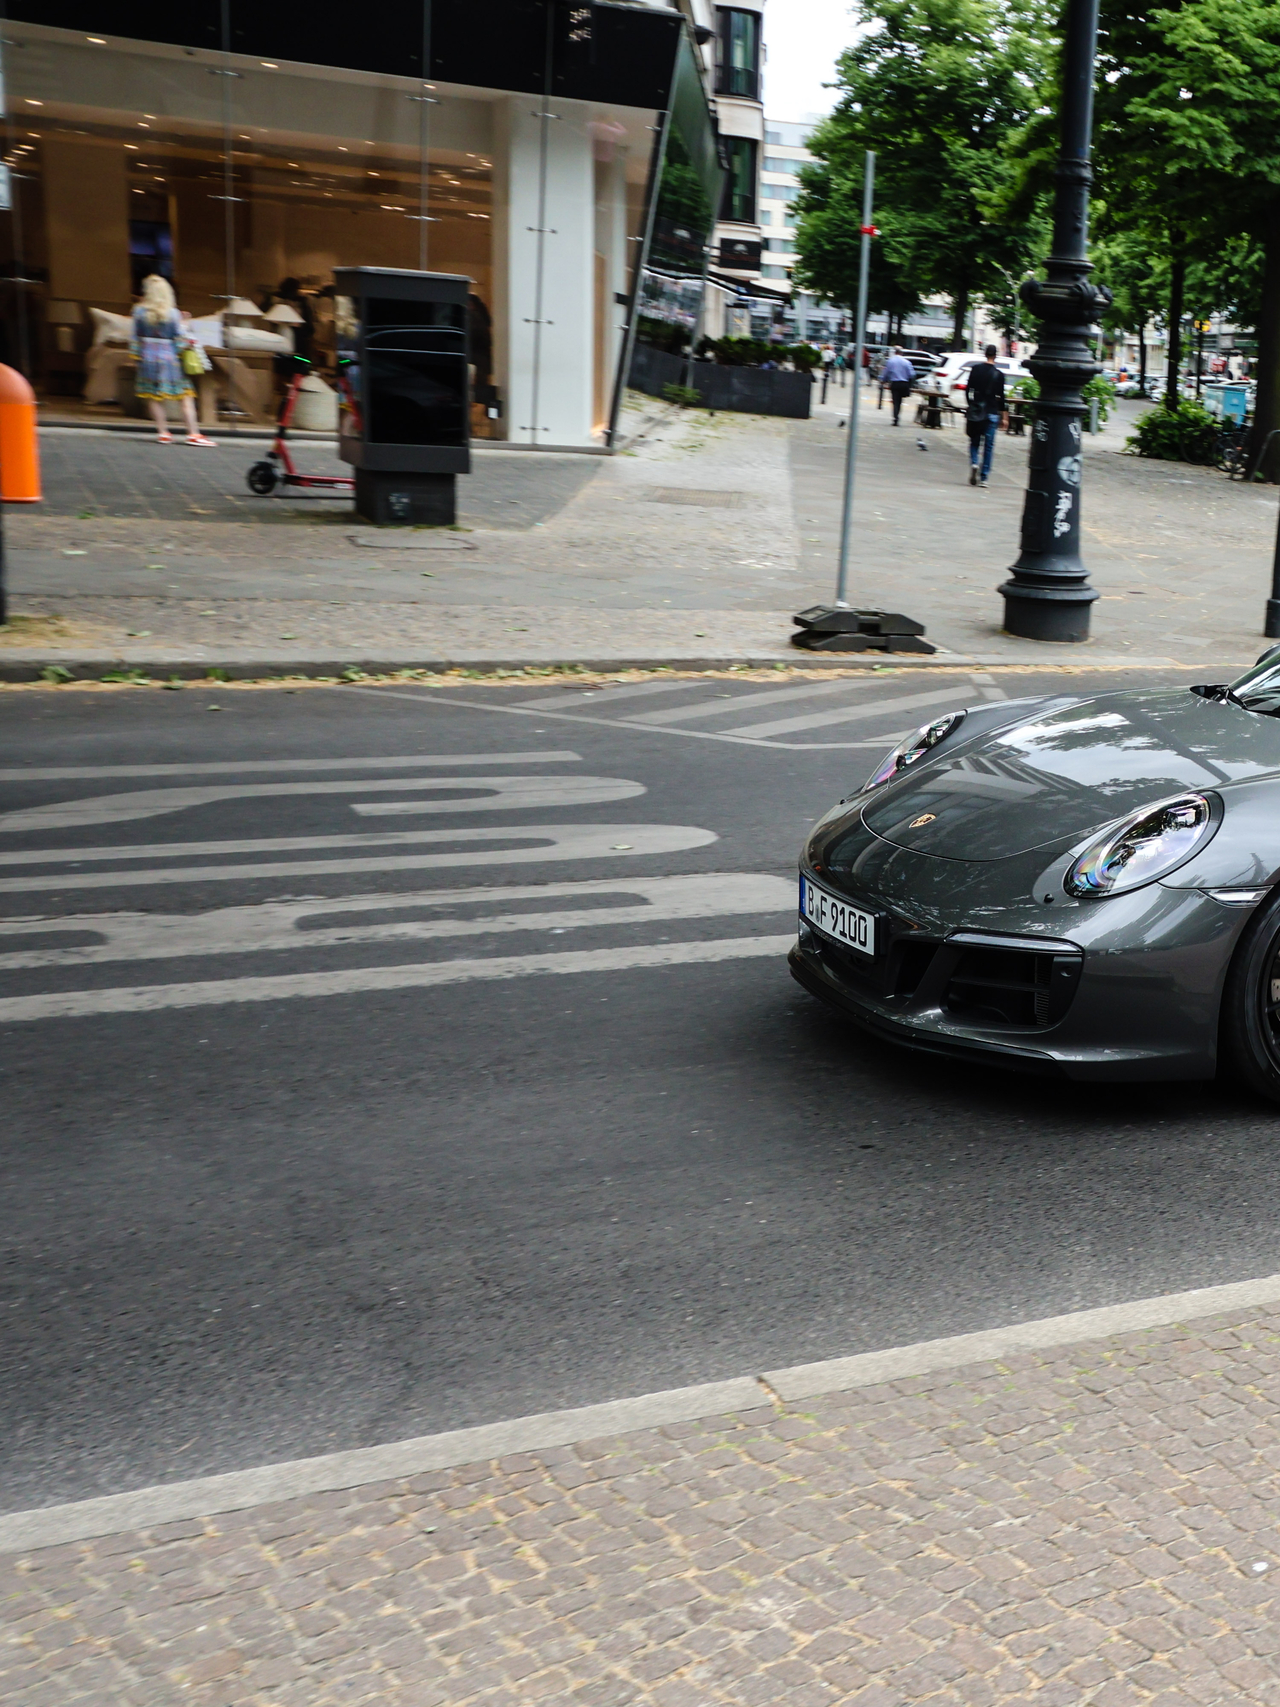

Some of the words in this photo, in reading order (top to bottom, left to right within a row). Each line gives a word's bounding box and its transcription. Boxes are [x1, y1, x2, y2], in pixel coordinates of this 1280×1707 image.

[807, 884, 815, 917] B
[820, 894, 828, 925] F
[830, 901, 868, 948] 9100
